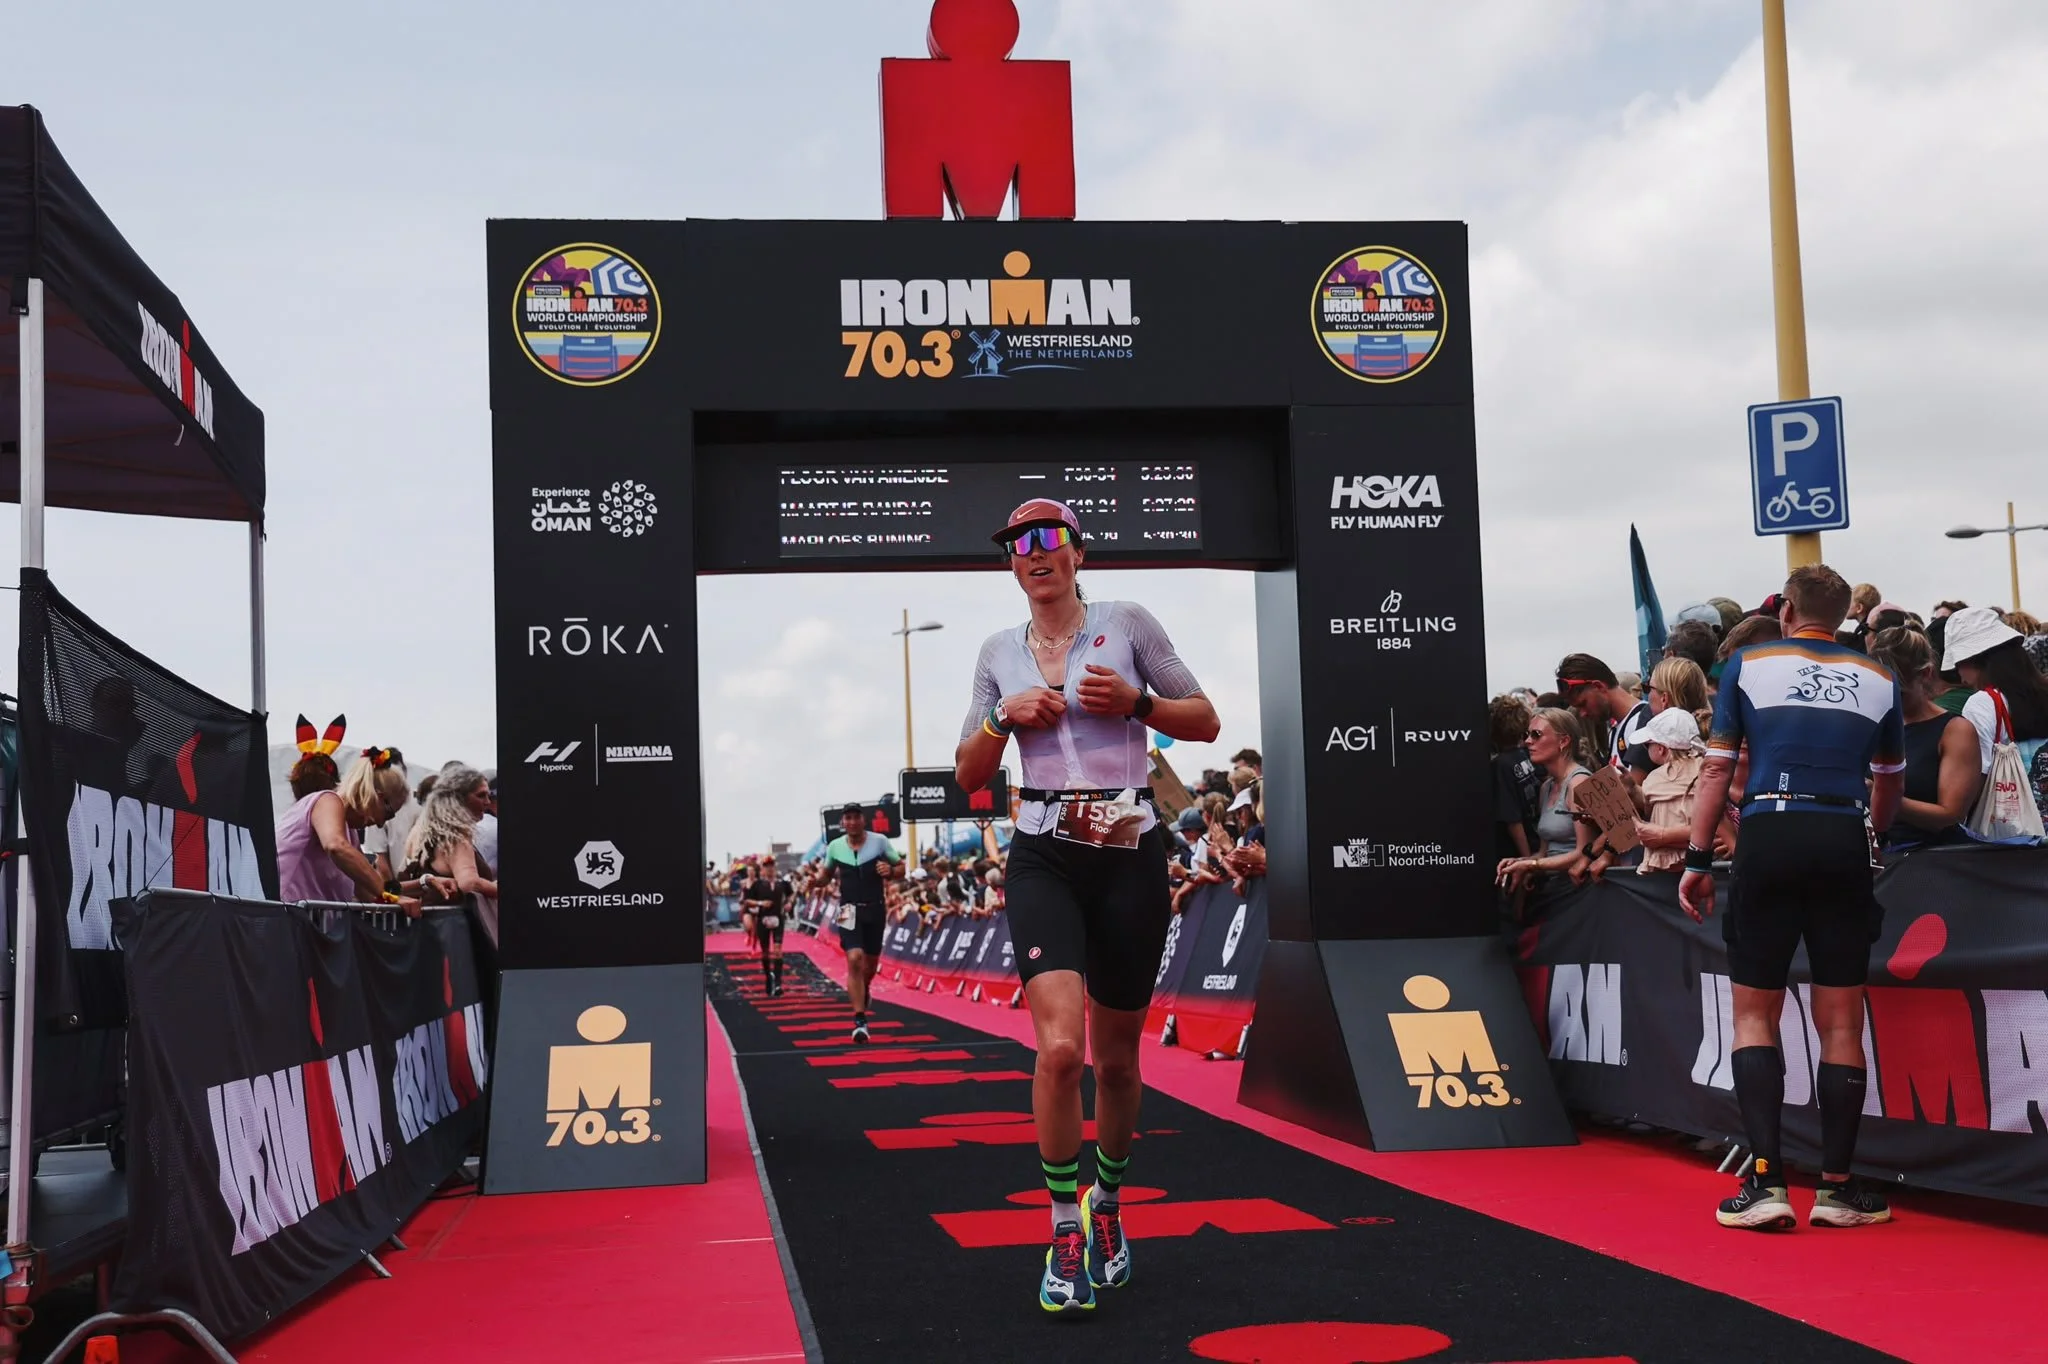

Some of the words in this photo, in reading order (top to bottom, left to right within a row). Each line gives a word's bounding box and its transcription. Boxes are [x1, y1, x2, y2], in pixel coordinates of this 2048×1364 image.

[840, 251, 1132, 326] IRONMAN
[526, 289, 613, 312] IRONMAN
[614, 298, 648, 313] 70.3
[1323, 291, 1403, 312] IRONMAN
[1403, 298, 1435, 312] 70.3
[527, 313, 565, 322] WORLD
[567, 312, 647, 322] CHAMPIONSHIP
[1324, 314, 1359, 322] WORLD
[1361, 312, 1435, 322] CHAMPIONSHIP
[1007, 335, 1132, 347] WESTFRIESLAND
[842, 330, 953, 378] 70.3
[1008, 350, 1032, 359] THE
[1037, 350, 1133, 359] NETHERLANDS
[137, 300, 216, 442] IRONMAN
[1771, 411, 1820, 476] P
[532, 487, 591, 498] Experience
[1331, 475, 1442, 508] HOKA
[532, 517, 591, 531] OMAN
[1331, 516, 1355, 529] FLY
[1357, 515, 1415, 528] HUMAN
[1418, 515, 1441, 528] FLY
[1330, 617, 1456, 633] BREITLING
[1377, 638, 1411, 650] 1884
[1326, 726, 1375, 751] AG1
[1405, 730, 1471, 742] ROUVY
[606, 746, 672, 757] NIRVANA
[540, 764, 573, 772] Hyperice
[910, 787, 945, 798] HOKA
[1388, 842, 1441, 854] Provincie
[1388, 853, 1475, 866] Noord-Holland
[537, 893, 664, 908] WESTFRIESLAND
[1407, 1073, 1511, 1108] 70.3
[207, 977, 387, 1256] IRONMAN
[546, 1109, 651, 1147] 70.3
